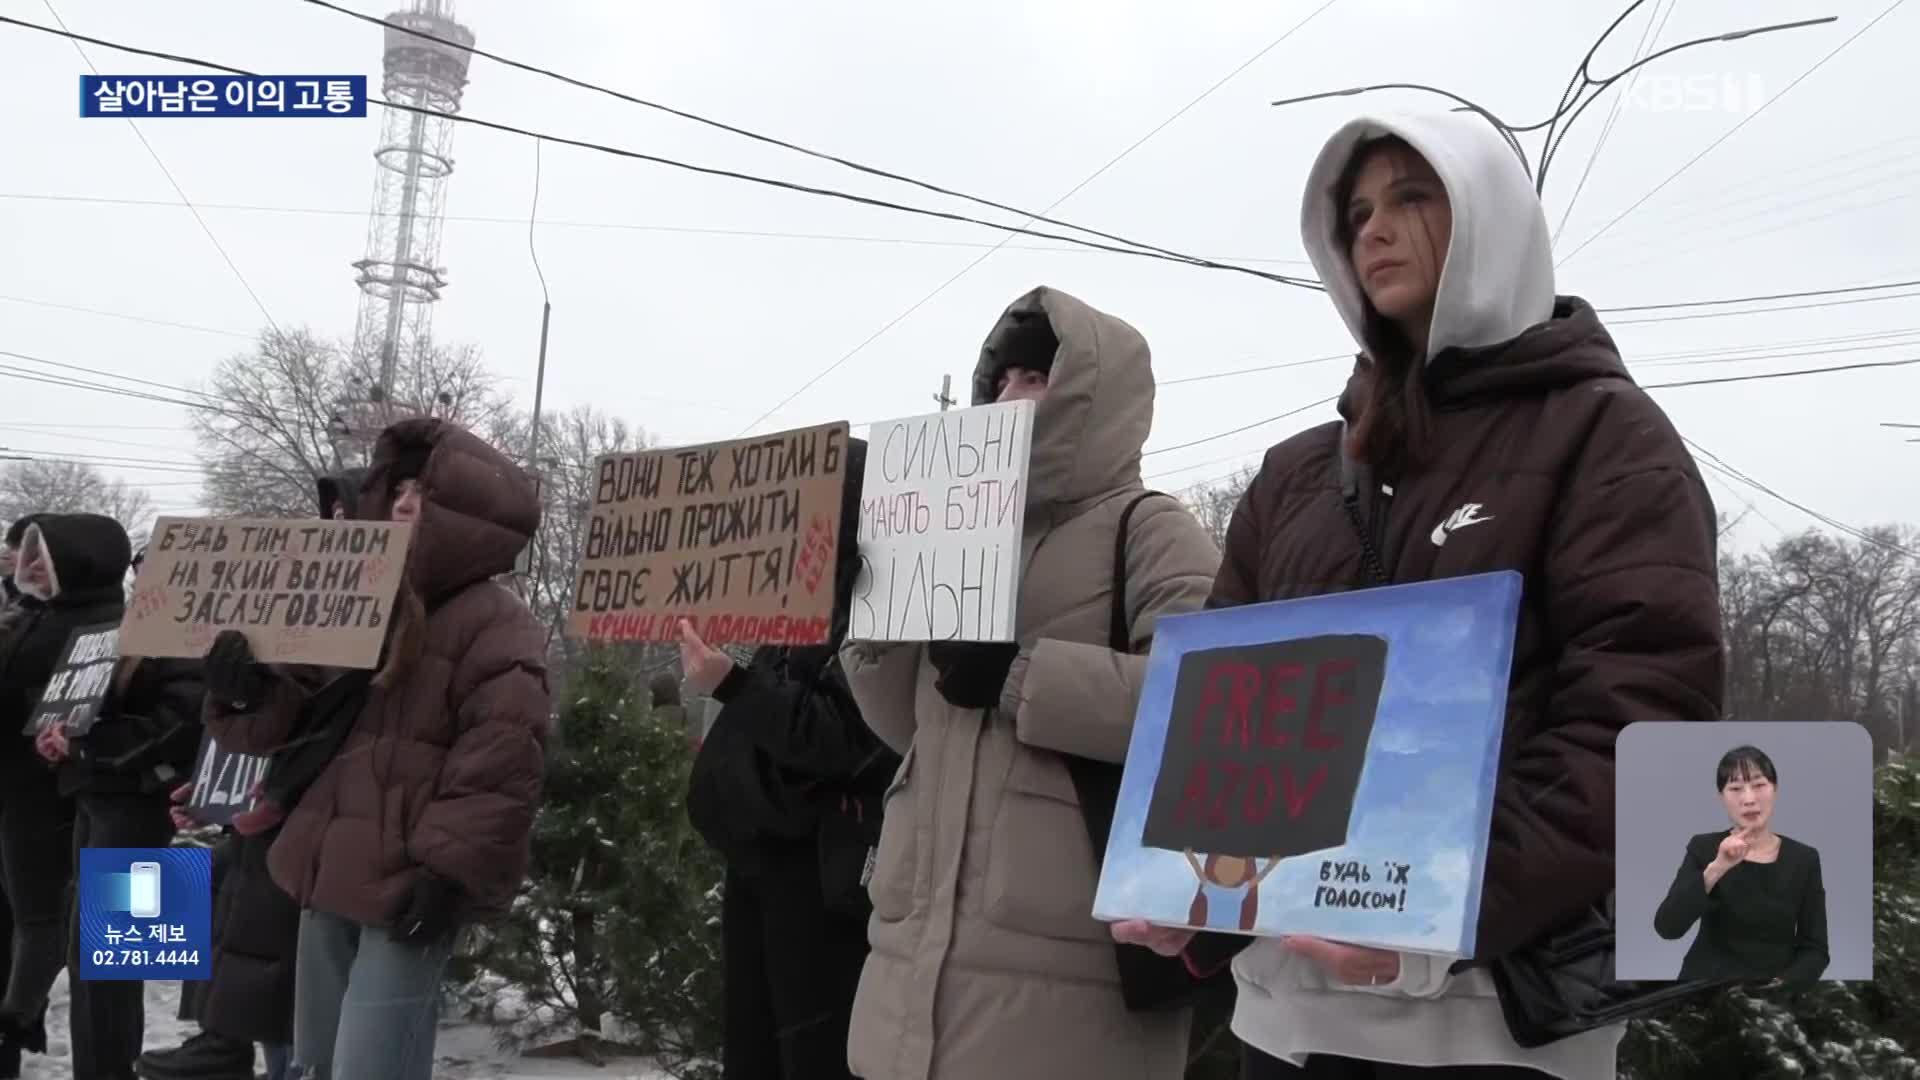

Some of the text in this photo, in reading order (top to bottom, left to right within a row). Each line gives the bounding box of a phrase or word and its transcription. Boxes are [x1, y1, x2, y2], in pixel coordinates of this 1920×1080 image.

[882, 406, 1018, 483] СИЛЬНІ
[597, 456, 662, 504] ВОНИ
[586, 489, 800, 560] ВІЛЬНО ПРОЖИТИ
[858, 480, 1019, 541] МАЮТЬ БУТИ
[158, 523, 390, 554] БУДЬ ТИМ ТИЛОМ
[168, 560, 199, 586] НА
[210, 554, 281, 591] ЯКИЙ
[286, 560, 365, 592] ВОНИ
[576, 539, 798, 612] СВОЄ ЖИТТЯ!
[174, 591, 382, 628] ЗАСЛУГОВУЮТЬ
[1190, 657, 1359, 752] FREE
[1173, 760, 1329, 831] AZOV
[1314, 885, 1406, 912] ГОЛОСОМ!
[1320, 860, 1410, 885] БУДЬ ЇХ
